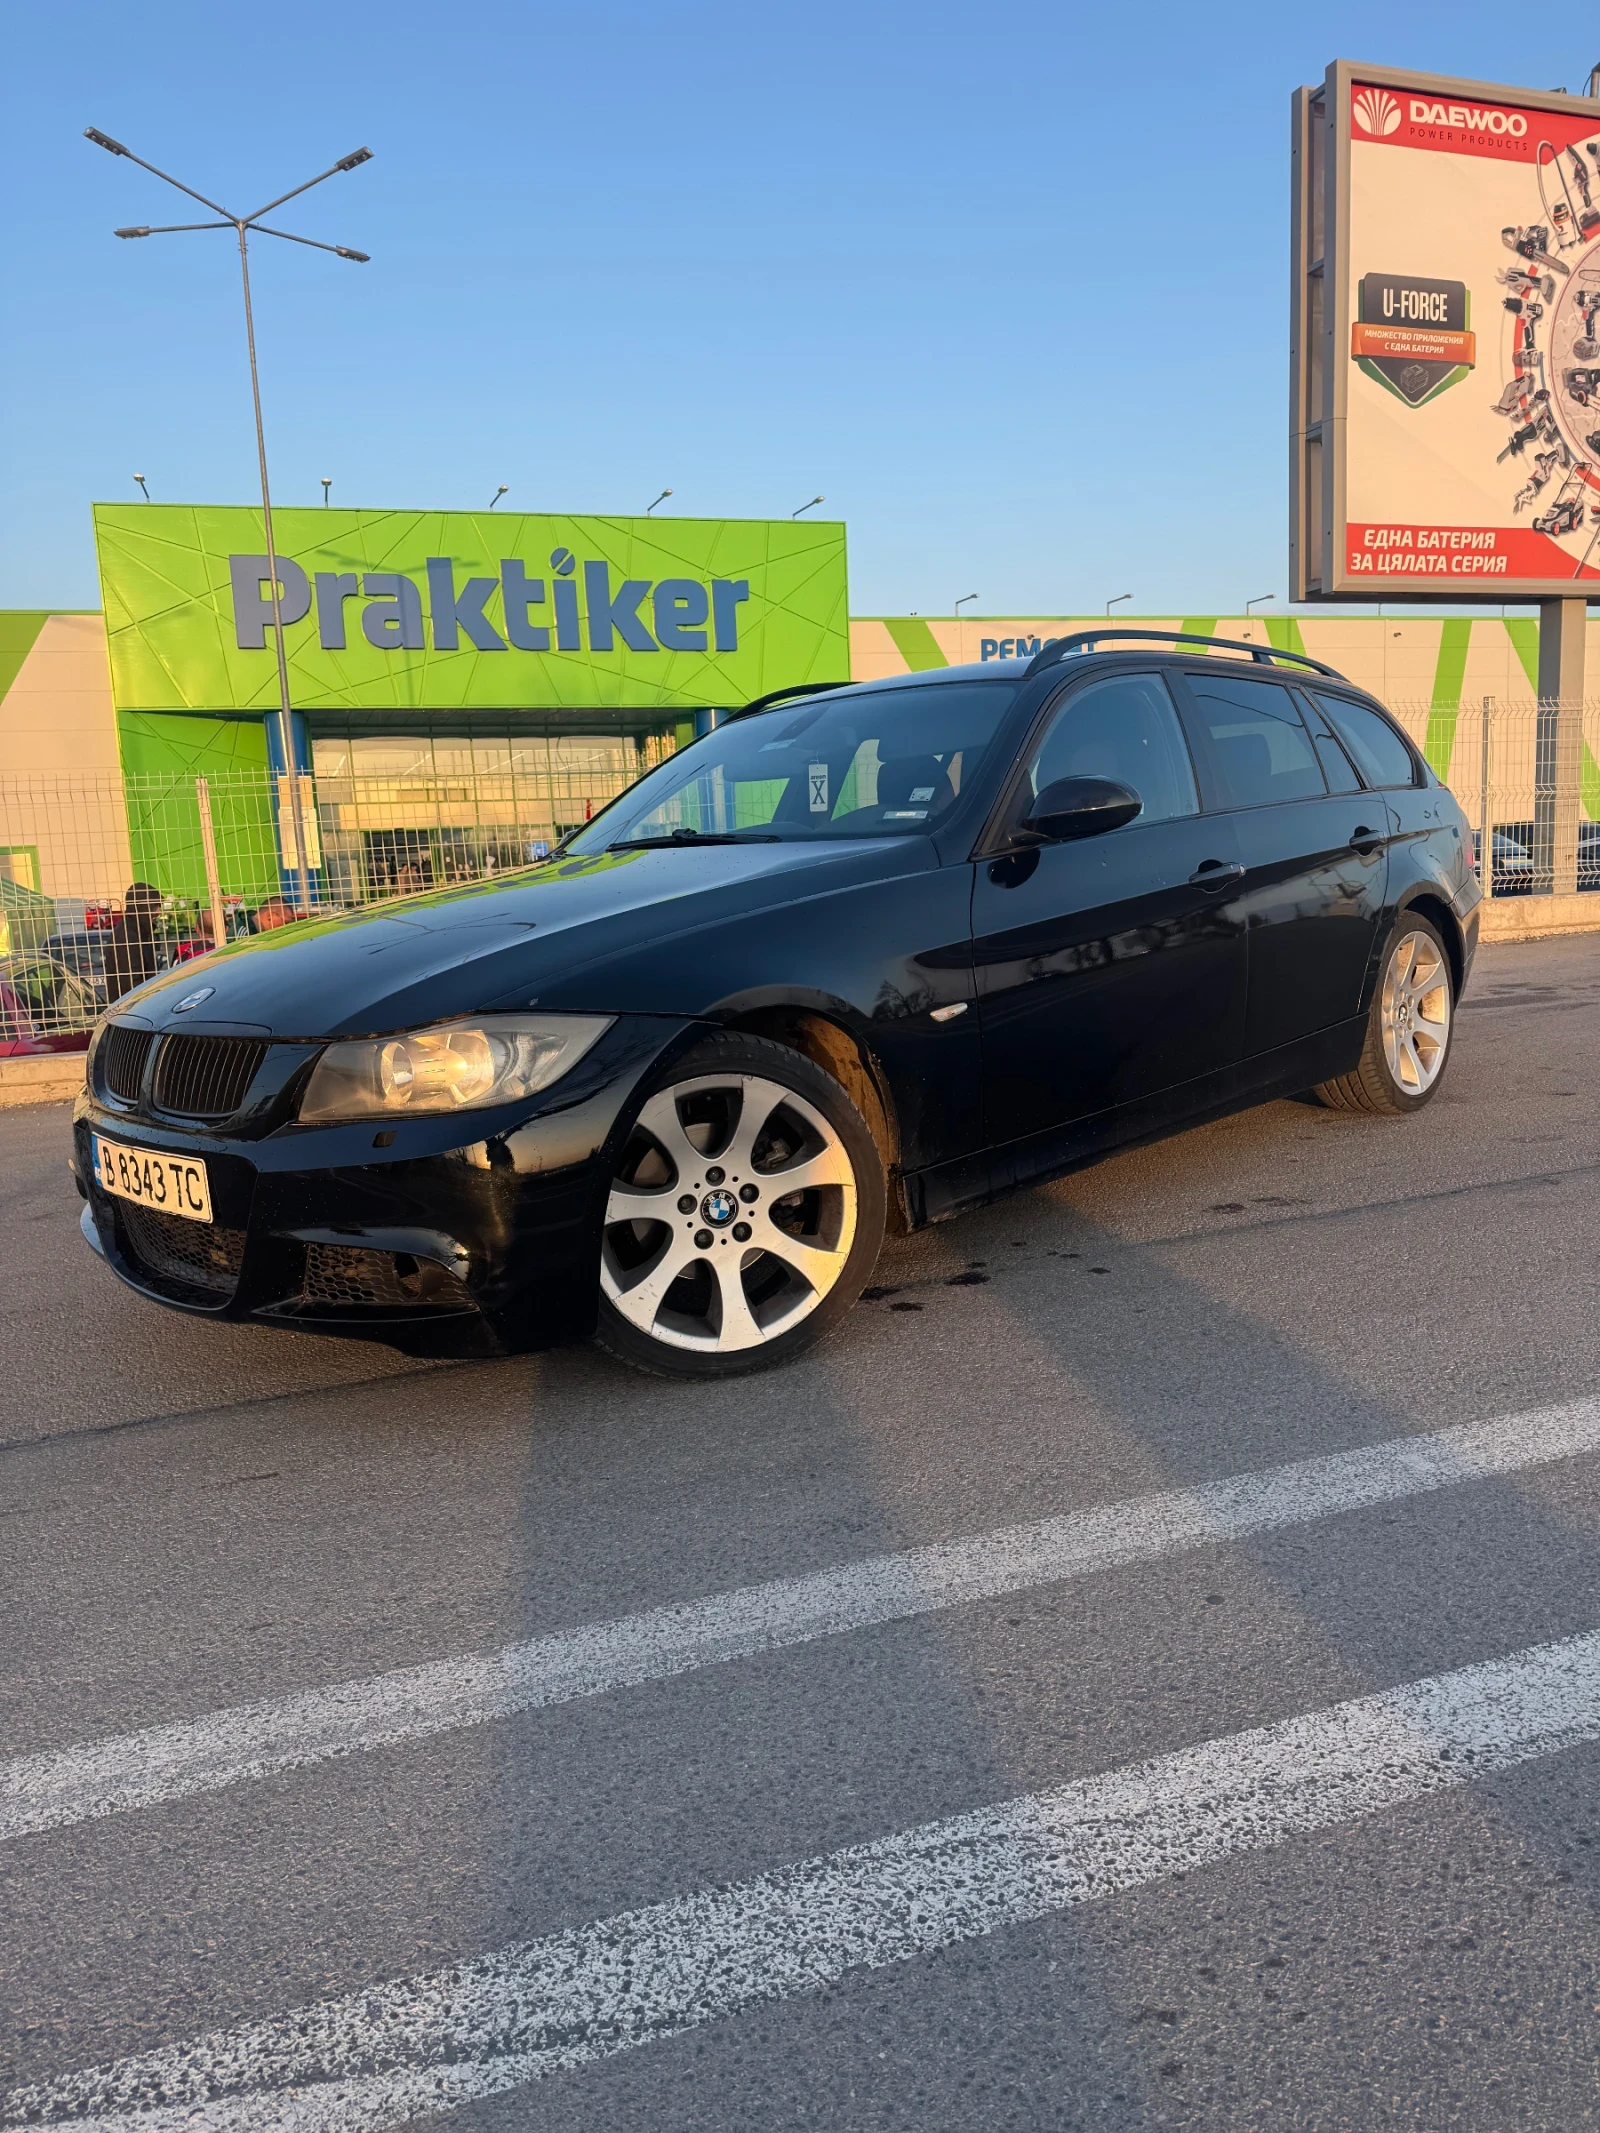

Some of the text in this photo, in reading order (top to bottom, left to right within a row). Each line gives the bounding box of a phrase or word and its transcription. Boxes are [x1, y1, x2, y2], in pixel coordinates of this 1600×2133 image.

[1409, 100, 1528, 137] DAEWOO
[1410, 127, 1528, 151] POWER PRODUCTS
[1383, 288, 1448, 322] U-FORCE
[1364, 329, 1464, 345] МНОЖЕСТВО ПРИЛОЖЕНИЯ
[1390, 343, 1410, 352] ЕДНА
[1411, 345, 1444, 354] БАТЕРИЯ
[1363, 529, 1496, 550] ЕДНА БАТЕРИЯ
[1351, 552, 1507, 573] ЗА ЦЯЛАТА СЕРИЯ
[229, 547, 749, 651] Praktiker
[811, 780, 826, 805] X
[103, 1146, 203, 1211] B 8343 TC
